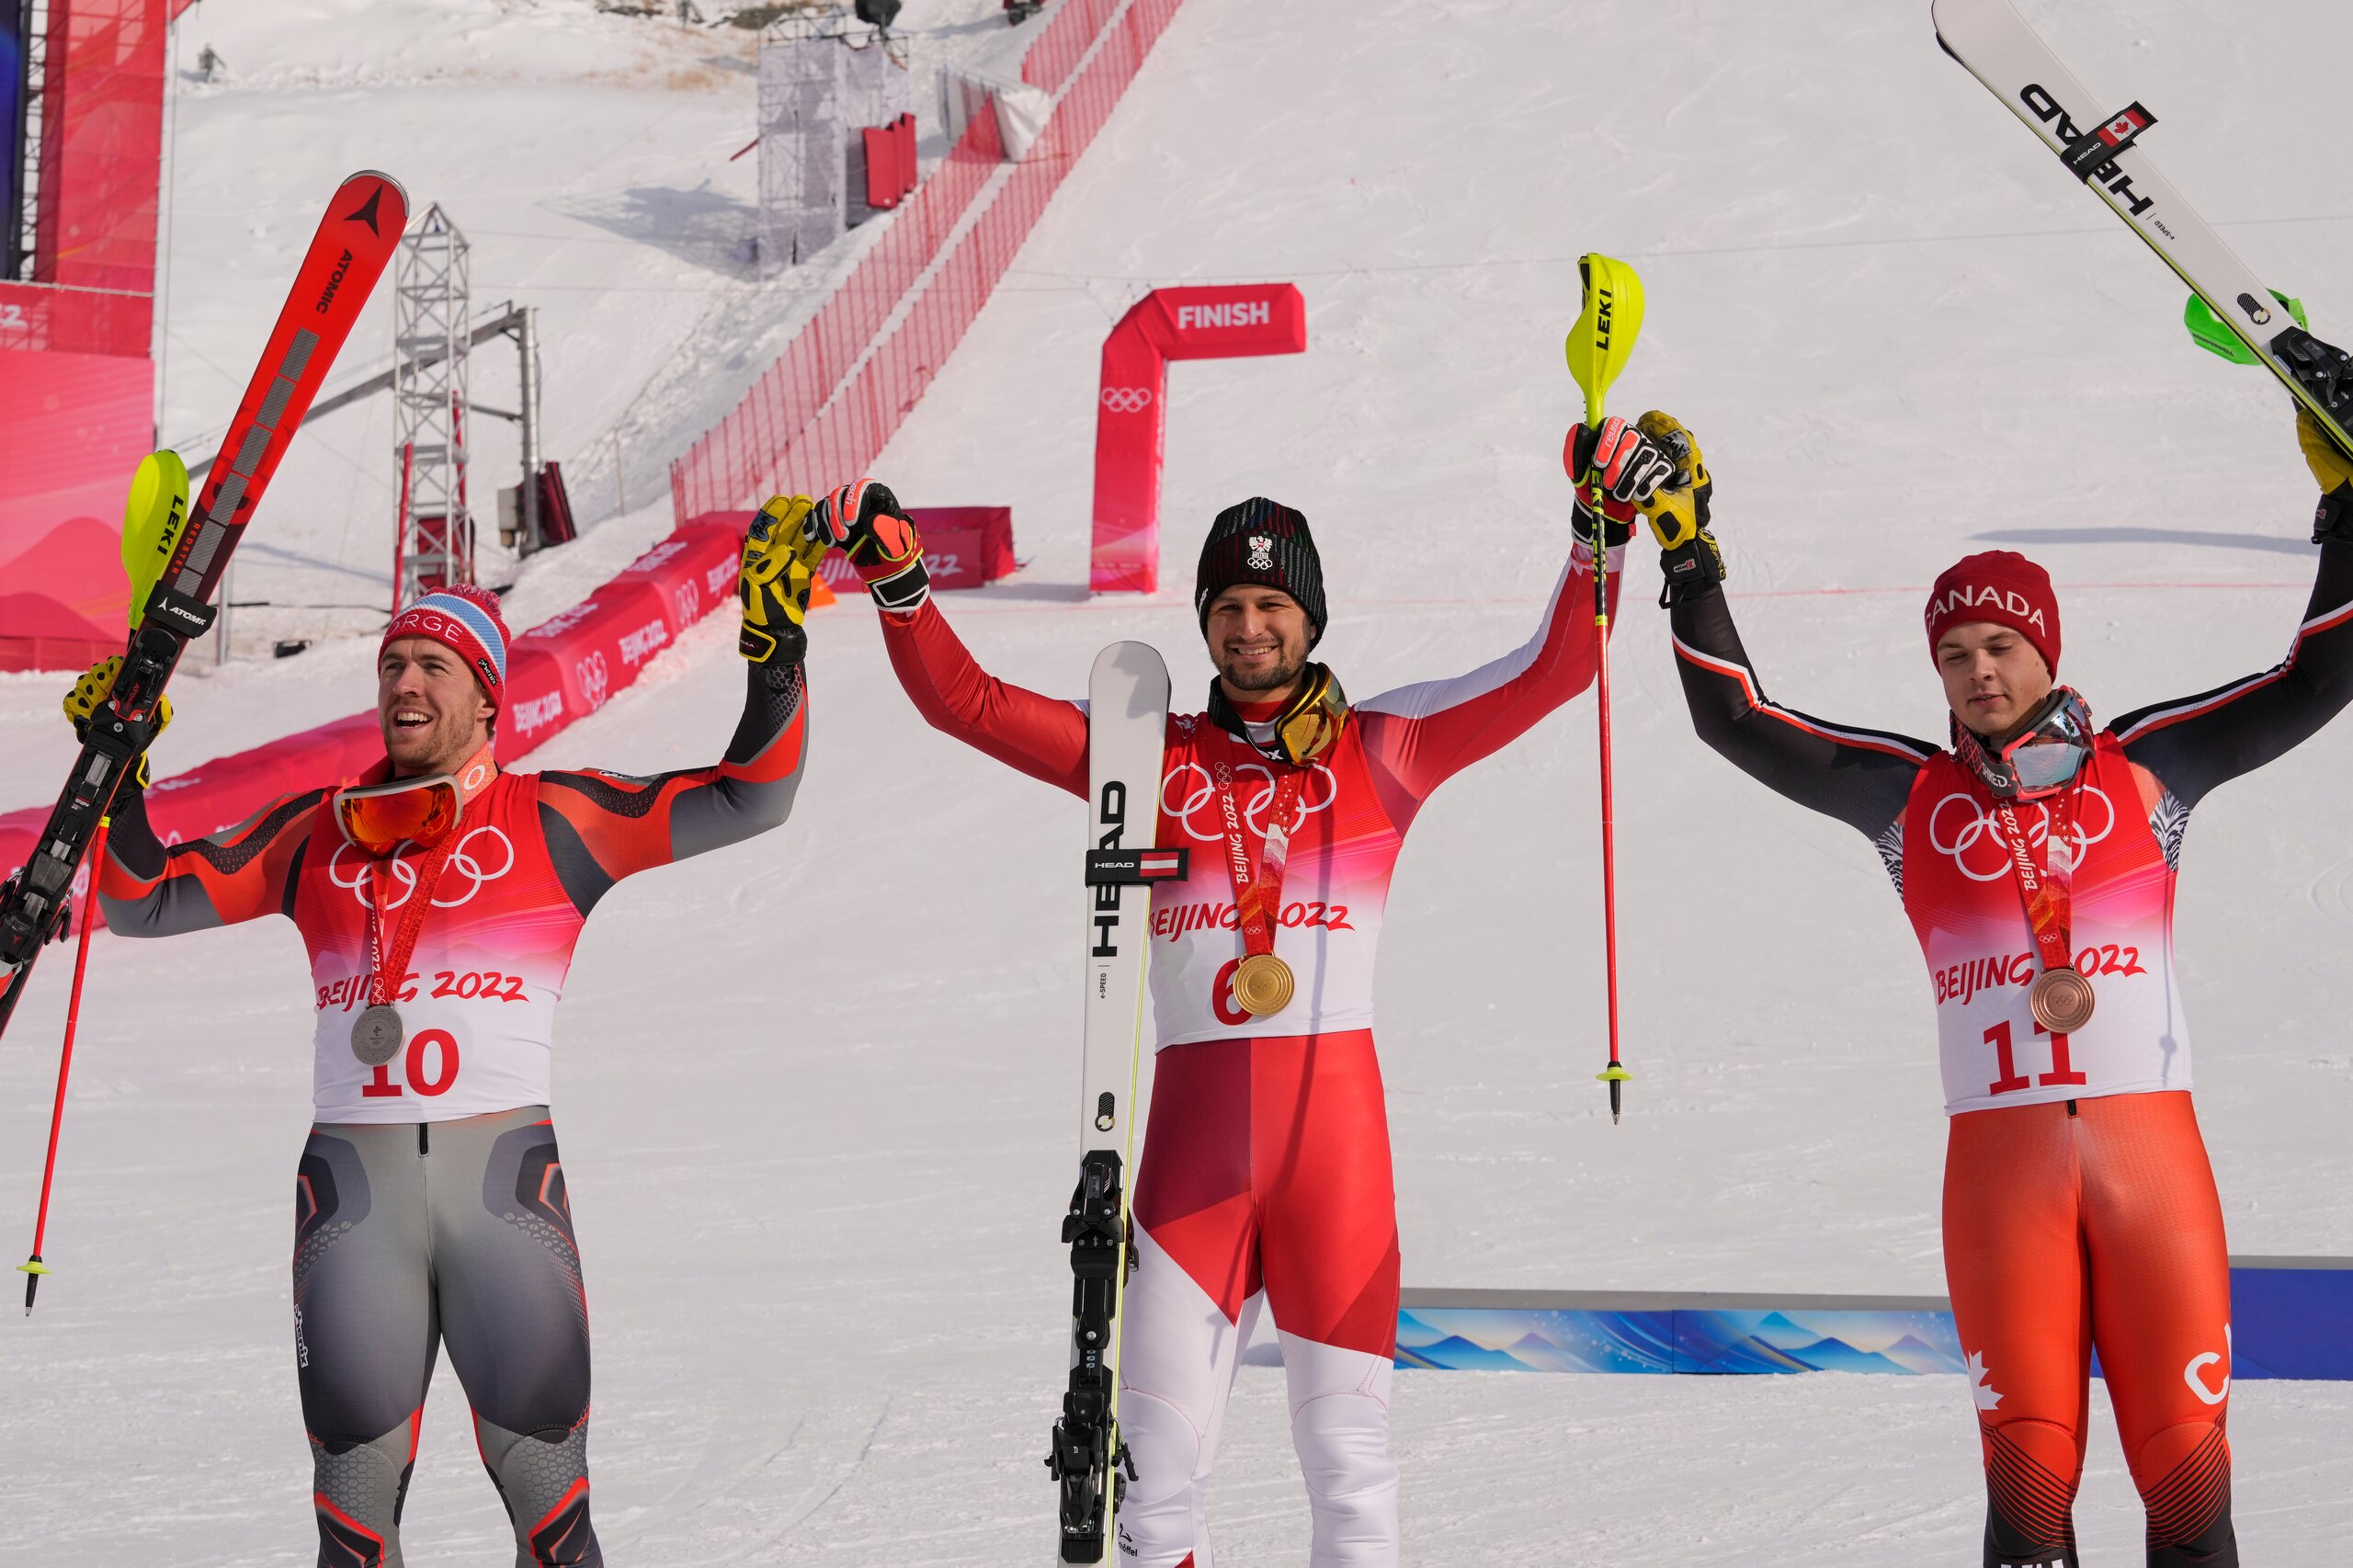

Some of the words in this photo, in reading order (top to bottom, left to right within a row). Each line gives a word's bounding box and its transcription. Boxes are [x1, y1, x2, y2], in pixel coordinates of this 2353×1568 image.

[2073, 142, 2102, 165] HEAD
[316, 248, 353, 314] ATOMIC
[0, 301, 28, 328] 2
[1178, 301, 1270, 329] FINISH
[1596, 289, 1612, 351] LEKI
[157, 494, 184, 555] LEKI
[171, 522, 201, 574] REDSTER
[169, 606, 207, 626] ATOMIC
[1222, 790, 1240, 829] 2022
[1998, 799, 2021, 835] 2022
[1092, 780, 1126, 957] HEAD
[1095, 861, 1135, 869] HEAD
[1230, 833, 1250, 885] BEIJING
[2011, 838, 2039, 892] BEIJING
[1276, 901, 1356, 932] 022
[317, 972, 421, 1013] BEIJIG
[429, 971, 530, 1004] 2022
[1936, 951, 2035, 1006] BEIJING
[2068, 943, 2148, 979] 022
[1983, 1018, 2086, 1096] 11
